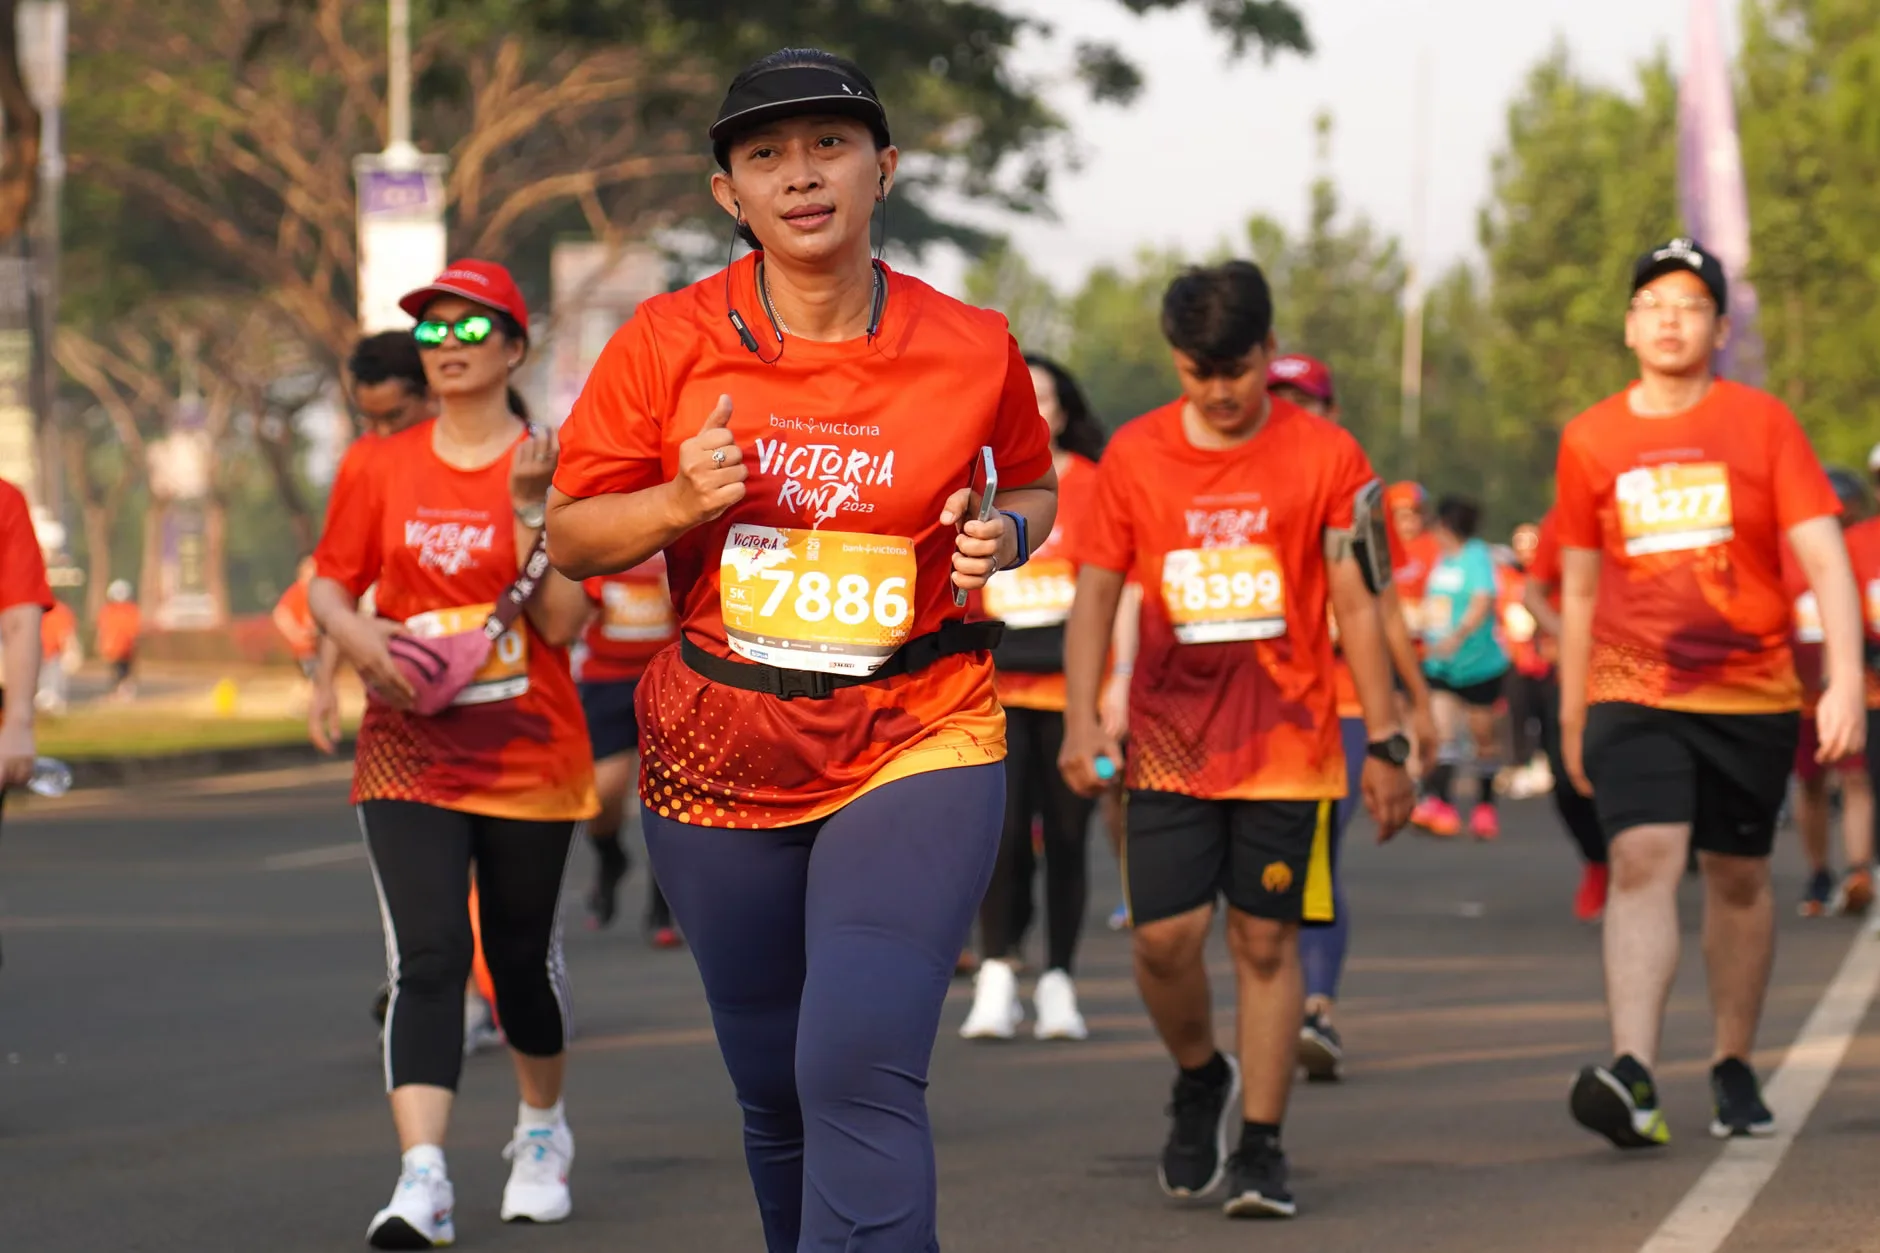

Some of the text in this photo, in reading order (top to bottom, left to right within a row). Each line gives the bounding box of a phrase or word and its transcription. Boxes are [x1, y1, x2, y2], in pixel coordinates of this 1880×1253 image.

[770, 413, 880, 436] bank victoria
[841, 501, 875, 513] 2023
[729, 587, 746, 600] 5K
[759, 568, 908, 627] 7886
[1184, 571, 1280, 610] 8399
